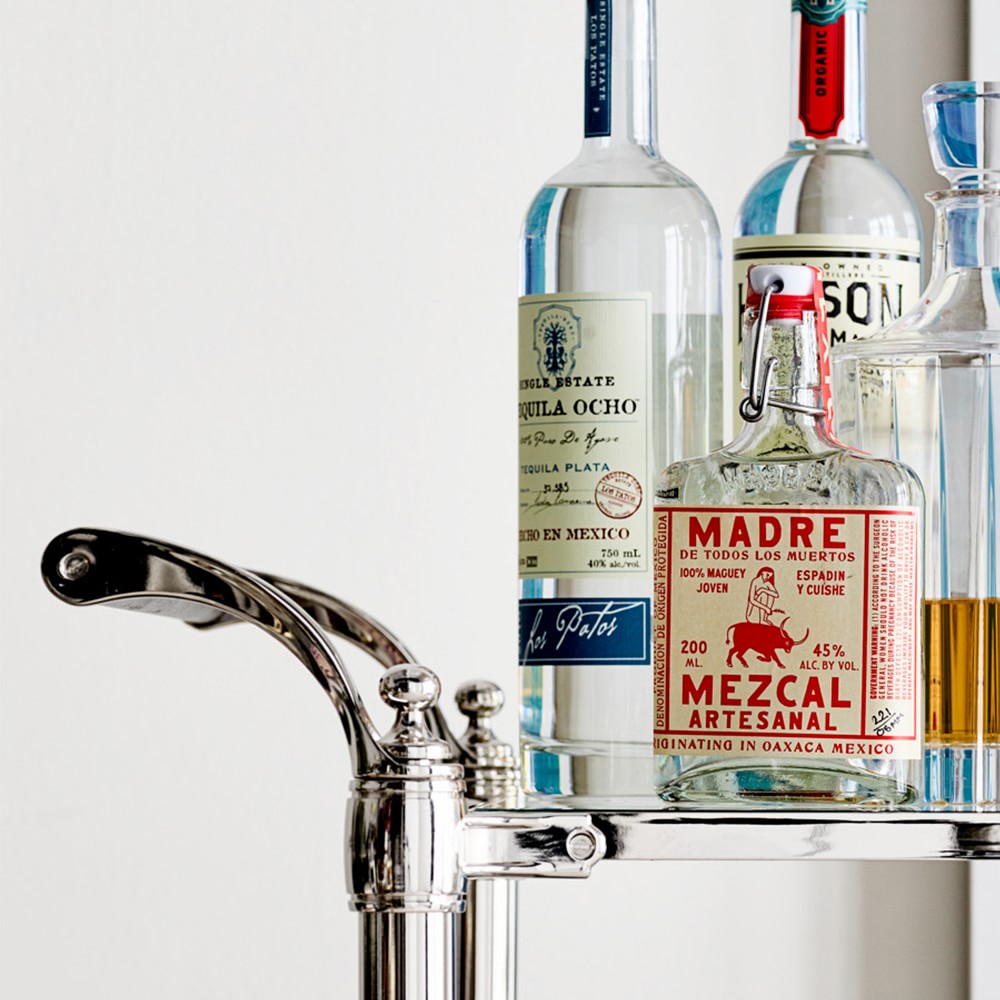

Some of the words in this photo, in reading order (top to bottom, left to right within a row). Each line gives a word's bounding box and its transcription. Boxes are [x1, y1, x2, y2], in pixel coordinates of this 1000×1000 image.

[590, 15, 598, 40] LOS
[599, 0, 607, 47] SINGLE
[590, 45, 598, 87] PATOS
[815, 30, 828, 97] ORGANIC
[599, 53, 607, 101] ESTATE
[556, 376, 615, 388] ESTATE
[573, 399, 637, 415] OCHO
[521, 463, 559, 474] TEQUILA
[565, 463, 610, 473] PLATA
[543, 528, 561, 541] EN
[566, 528, 630, 541] MEXICO
[689, 516, 846, 549] MADRE
[658, 515, 668, 579] PROTEGIDA
[881, 520, 889, 561] ALCOHOLIC
[601, 549, 618, 558] 750
[623, 549, 640, 558] mL
[680, 549, 698, 560] DE
[704, 549, 749, 560] TODOS
[755, 550, 781, 561] LOS
[787, 551, 856, 562] MUERTOS
[872, 551, 880, 563] THE
[587, 560, 606, 568] 40%
[872, 564, 880, 572] TO
[680, 568, 705, 578] 100%
[707, 568, 746, 579] MAGUEY
[797, 570, 845, 581] ESPADIN
[696, 582, 728, 593] JOVEN
[797, 584, 804, 595] Y
[807, 585, 845, 595] CUISHE
[657, 582, 667, 620] ORIGEN
[880, 589, 888, 602] NOT
[556, 601, 643, 650] Patos
[657, 625, 666, 639] DE
[681, 640, 707, 654] 200
[813, 643, 845, 657] 45%
[879, 636, 887, 663] WOMEN
[685, 658, 703, 667] ML.
[800, 660, 820, 670] ALC.
[822, 661, 835, 671] BY
[838, 661, 859, 671] VOL.
[656, 643, 665, 728] DENOMINACION
[870, 657, 878, 700] GOVERNMENT
[682, 674, 851, 708] MEZCAL
[689, 709, 837, 731] ARTESANAL
[740, 740, 756, 751] IN
[762, 741, 824, 753] OAXACA
[832, 743, 894, 755] MEXICO
